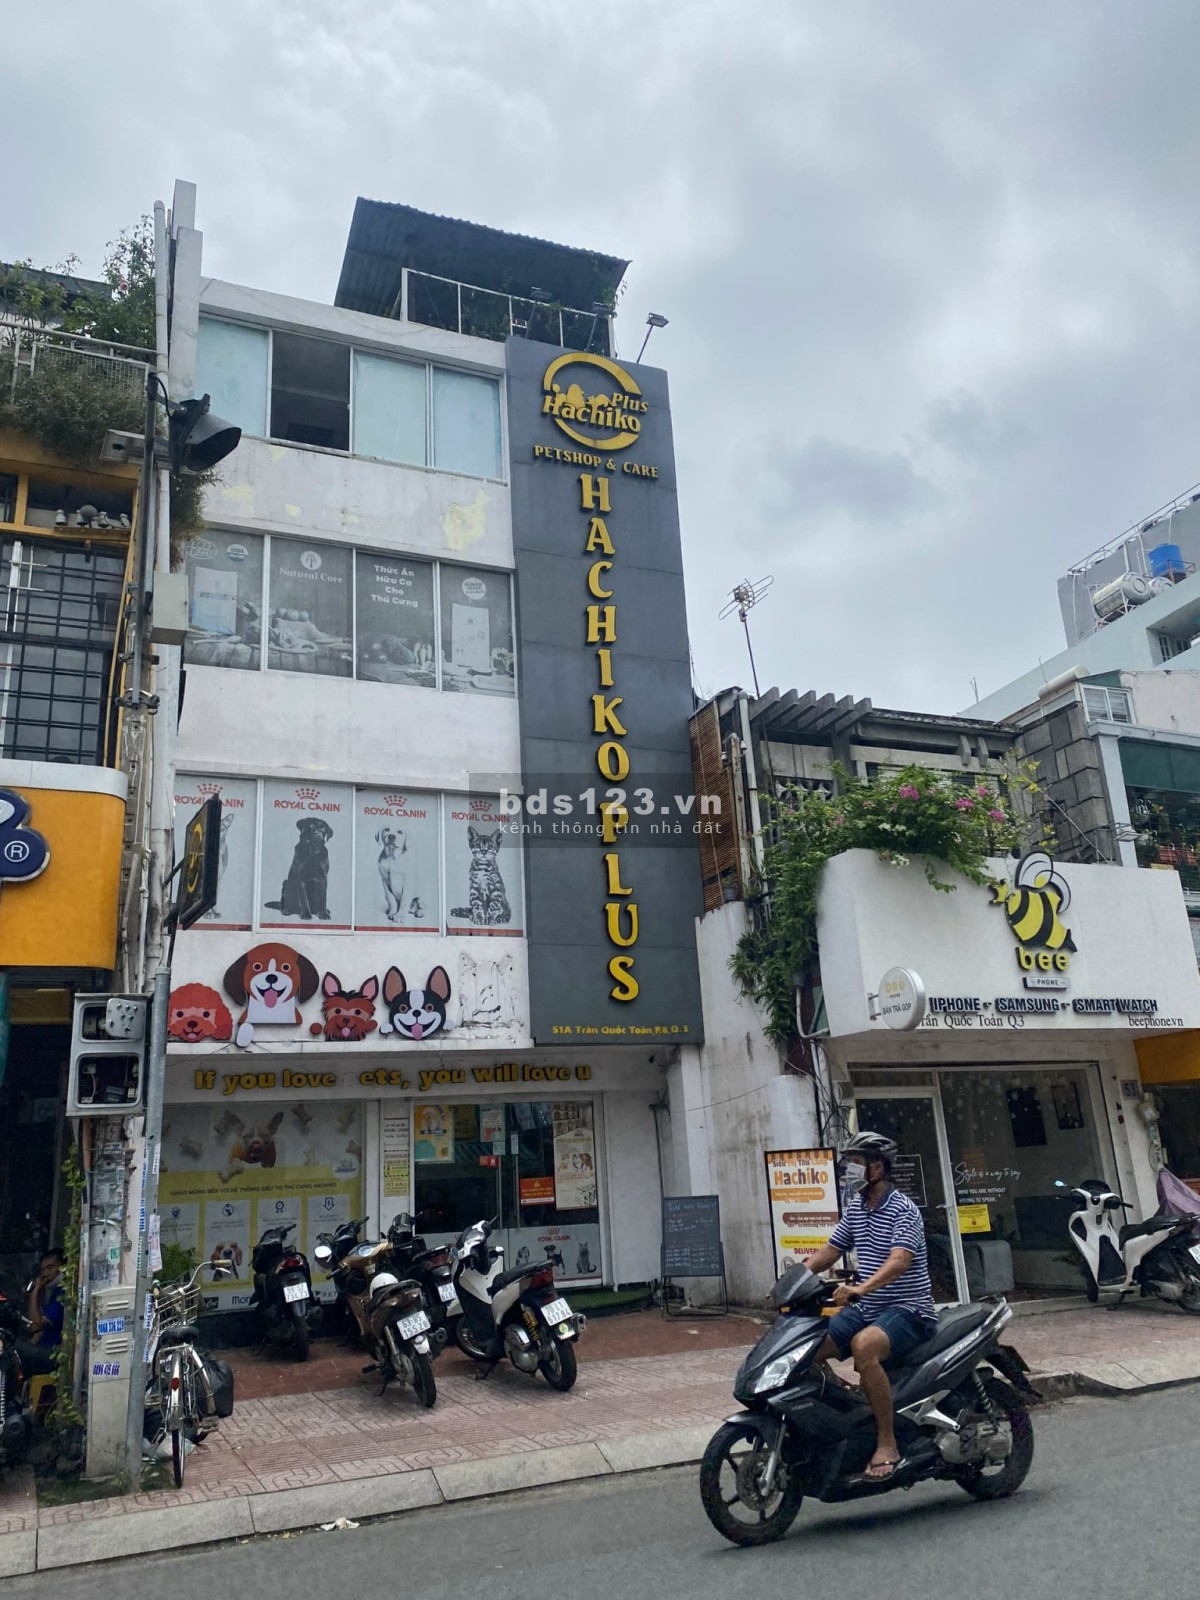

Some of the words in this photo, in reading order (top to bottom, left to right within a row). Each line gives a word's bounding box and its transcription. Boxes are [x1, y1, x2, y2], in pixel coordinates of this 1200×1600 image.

[611, 391, 648, 413] Plus
[542, 395, 641, 433] Hachiko
[534, 444, 602, 467] PETSHOP
[605, 458, 617, 471] &
[622, 460, 659, 479] CARE
[279, 567, 318, 580] Natural
[320, 573, 343, 583] Core
[373, 564, 399, 575] Thức
[376, 574, 397, 585] Hữu
[398, 578, 413, 586] Cơ
[385, 586, 404, 595] Cho
[370, 593, 390, 603] Thú
[392, 597, 419, 608] Cưng
[579, 473, 630, 781] HACHIKO
[274, 800, 305, 810] ROYAL
[308, 802, 341, 812] CANIN
[364, 807, 394, 817] ROYAL
[395, 809, 426, 819] CANIN
[451, 812, 479, 822] ROYAL
[481, 814, 510, 823] CANIN
[1015, 946, 1070, 972] bee
[931, 997, 981, 1012] IPHONE
[996, 998, 1060, 1012] SAMSUNG
[552, 1025, 572, 1034] 51A
[601, 1023, 626, 1034] Quốc
[944, 1013, 972, 1029] Quốc
[976, 1013, 1003, 1027] Toản
[1007, 1014, 1025, 1029] Q.3
[1128, 1014, 1184, 1028] beephone.vn
[194, 1069, 217, 1089] If
[223, 1072, 276, 1096] you
[282, 1069, 337, 1088] love
[419, 1069, 466, 1091] you
[471, 1063, 519, 1082] will
[522, 1064, 572, 1082] love
[575, 1065, 592, 1081] u
[1124, 1082, 1137, 1097] 53
[773, 1167, 829, 1186] Hachiko
[954, 1161, 977, 1186] Style
